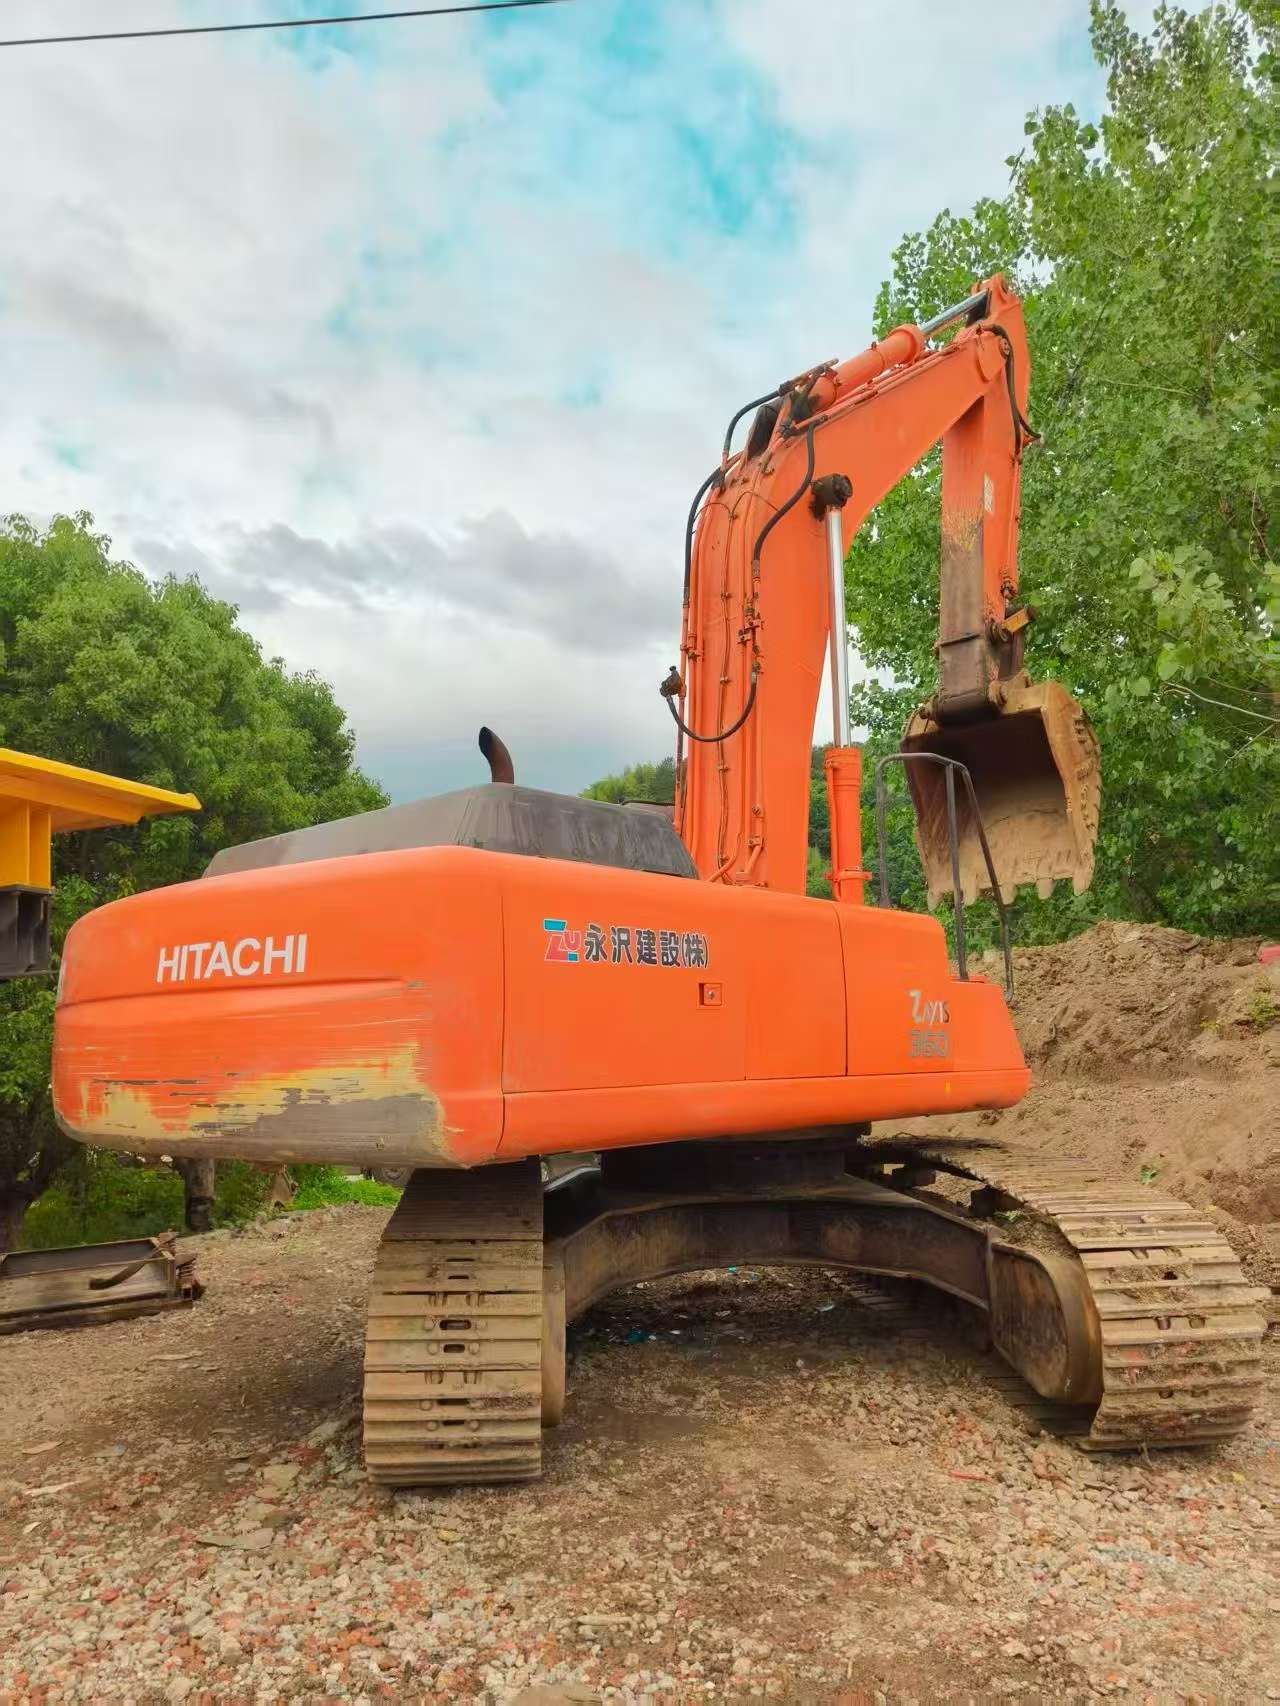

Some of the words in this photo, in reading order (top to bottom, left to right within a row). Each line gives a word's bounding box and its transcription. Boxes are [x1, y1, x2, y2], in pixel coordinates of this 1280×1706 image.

[156, 933, 308, 983] HITACHI
[584, 923, 709, 968] 永沢建設(株)
